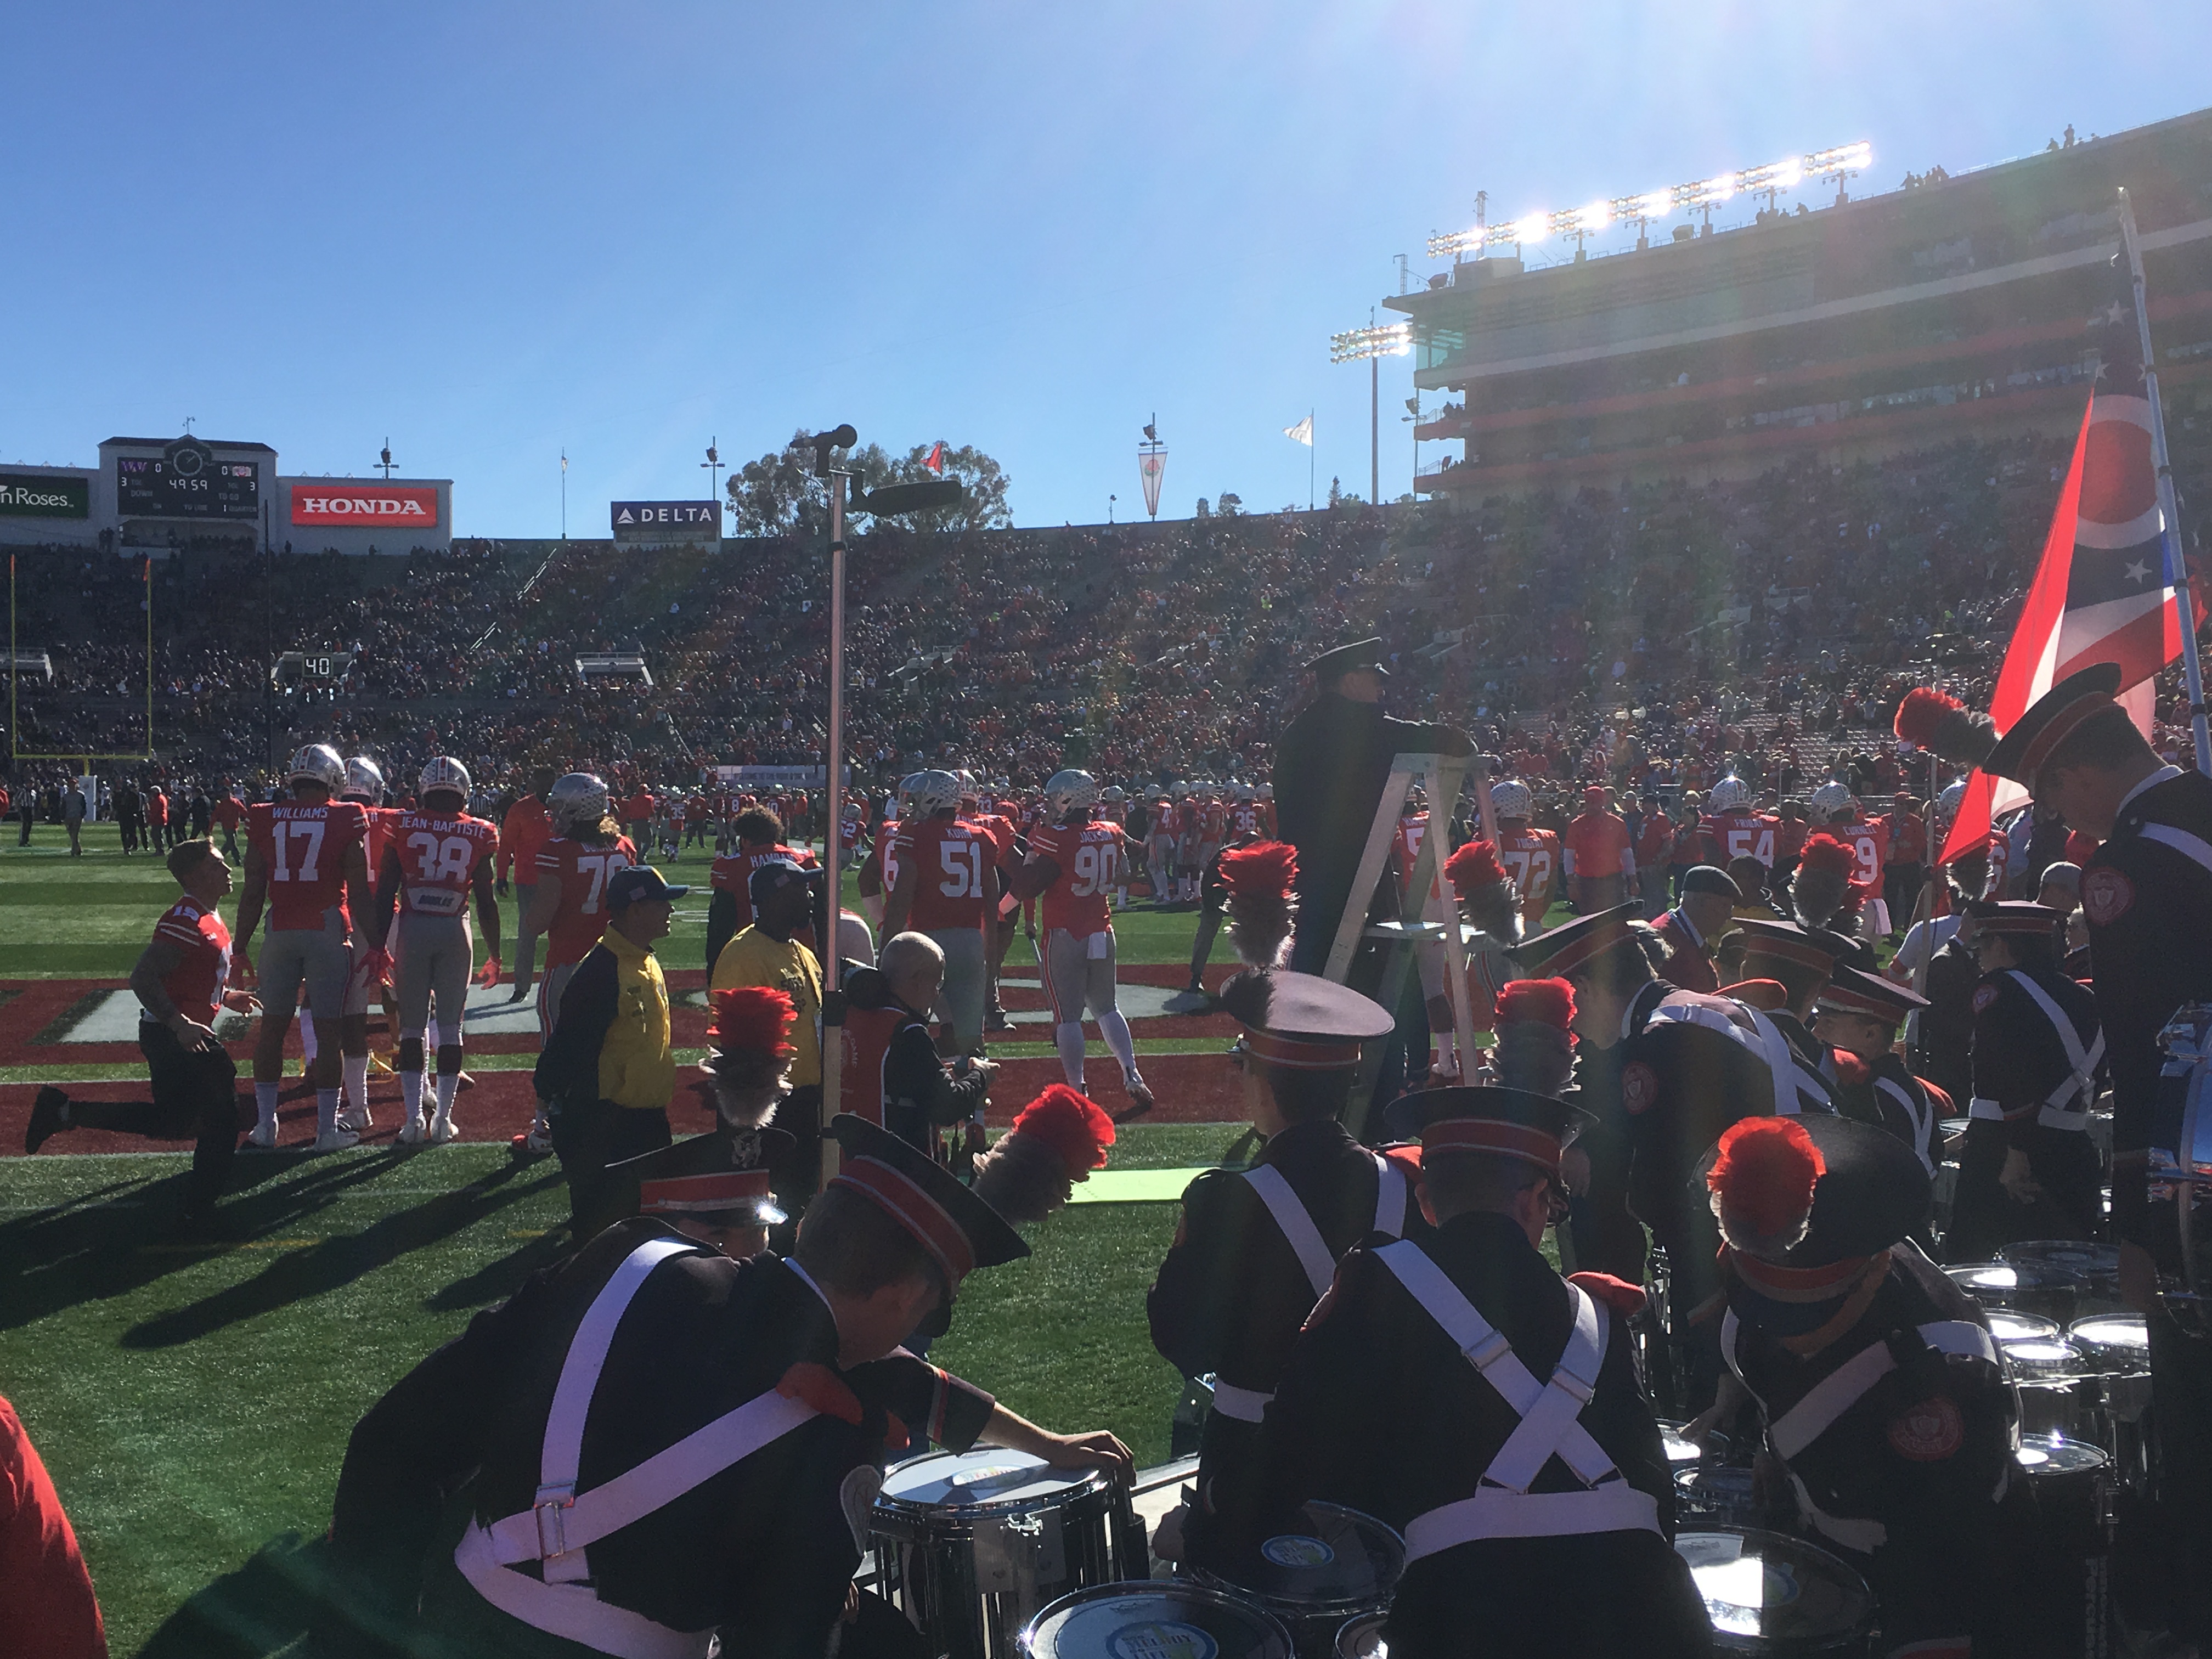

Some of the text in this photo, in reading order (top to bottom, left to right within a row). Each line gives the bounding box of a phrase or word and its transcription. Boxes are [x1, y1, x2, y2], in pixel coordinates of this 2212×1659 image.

[155, 463, 161, 472] 0
[222, 466, 228, 475] 0
[121, 477, 127, 487] 3
[250, 482, 256, 491] 3
[303, 498, 426, 515] HONDA
[641, 508, 713, 522] DELTA
[306, 658, 329, 675] 40
[273, 806, 329, 819] WILLIAMS
[670, 807, 685, 820] 35
[731, 799, 739, 812] 8
[399, 816, 486, 839] JEAN-BAPTISTE
[1235, 811, 1256, 831] 36
[1079, 830, 1113, 843] JACKSON
[272, 821, 325, 882] 17
[407, 832, 472, 883] 38
[1728, 830, 1774, 868] 54
[1856, 837, 1878, 883] 9
[940, 841, 983, 898] 51
[1071, 844, 1117, 896] 90
[1504, 851, 1551, 899] 72
